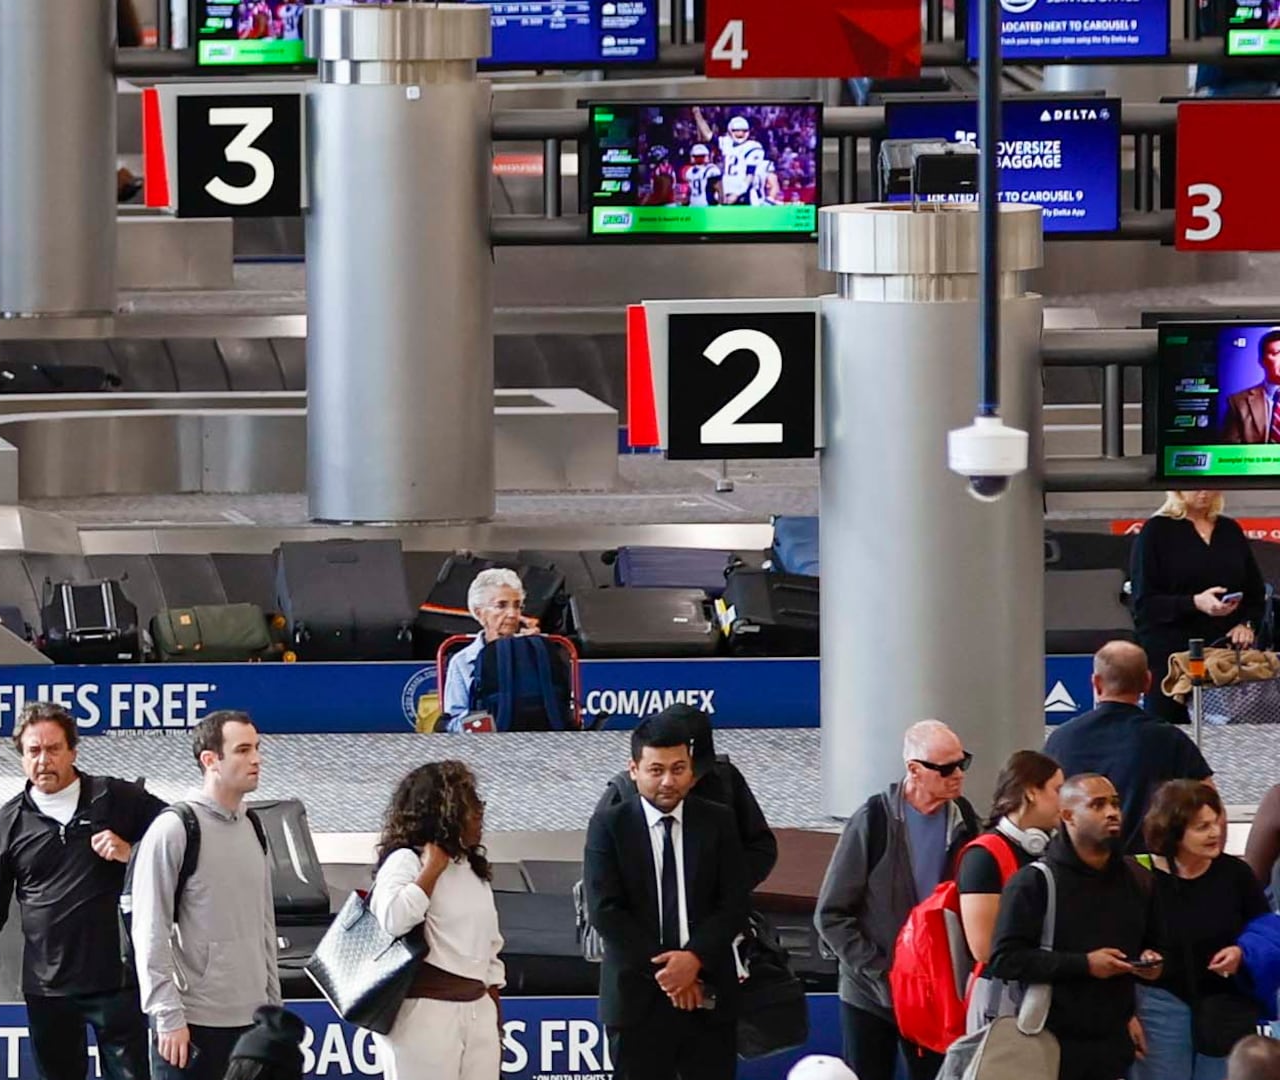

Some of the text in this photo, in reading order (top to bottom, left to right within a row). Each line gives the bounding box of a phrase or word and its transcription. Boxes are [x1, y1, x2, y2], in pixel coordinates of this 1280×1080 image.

[1001, 21, 1043, 33] LOCATED
[1044, 21, 1068, 32] NEXT
[1070, 20, 1082, 32] TO
[1083, 19, 1130, 31] CAROUSEL
[711, 19, 749, 70] 4
[1053, 109, 1098, 121] DELTA
[997, 140, 1061, 155] OVERSIZE
[204, 106, 275, 206] 3
[1005, 191, 1020, 202] TO
[1021, 190, 1073, 202] CAROUSEL
[1075, 189, 1084, 201] 9
[1053, 207, 1071, 217] Delta
[1072, 207, 1086, 218] App
[1184, 183, 1224, 242] 3
[700, 327, 784, 445] 2
